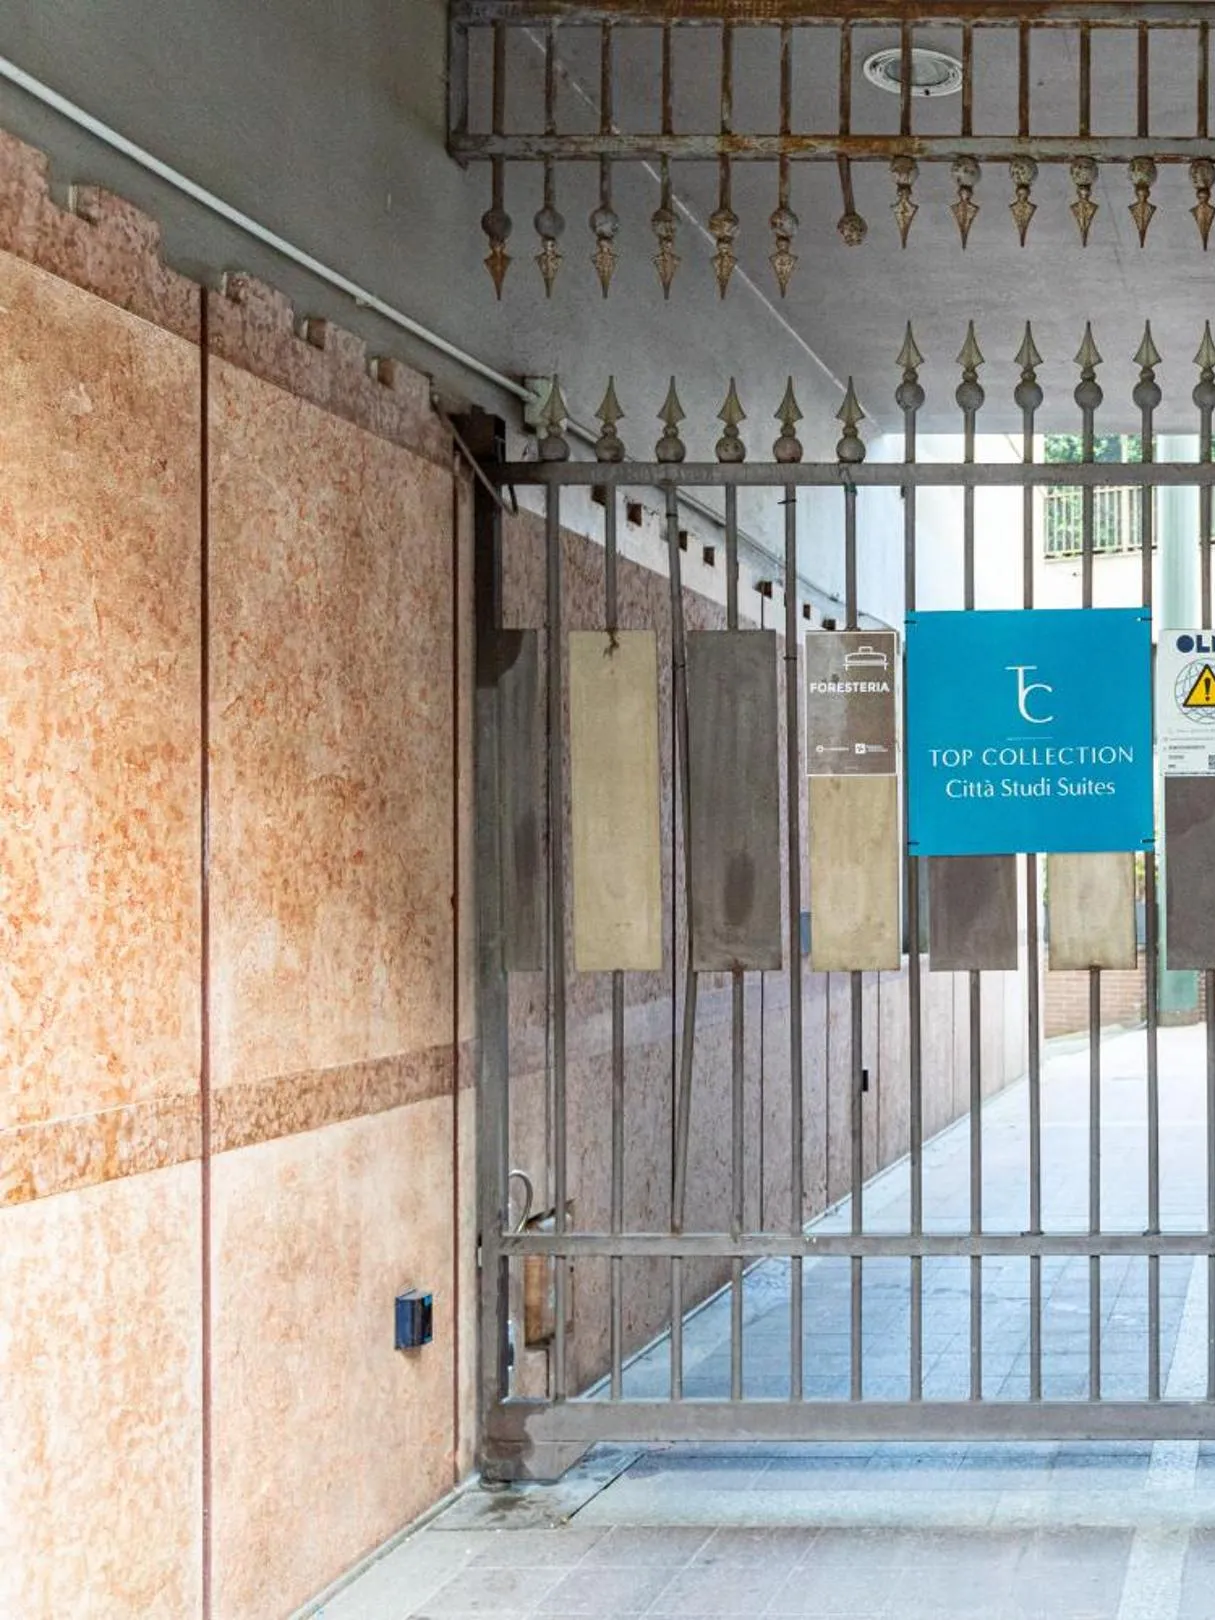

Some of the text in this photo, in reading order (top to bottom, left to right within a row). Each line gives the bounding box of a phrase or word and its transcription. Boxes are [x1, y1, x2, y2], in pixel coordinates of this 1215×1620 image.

[809, 681, 890, 694] FORESTERIA
[929, 745, 1134, 768] TOP COLLECTION
[945, 776, 1116, 798] Città Studi Suites
